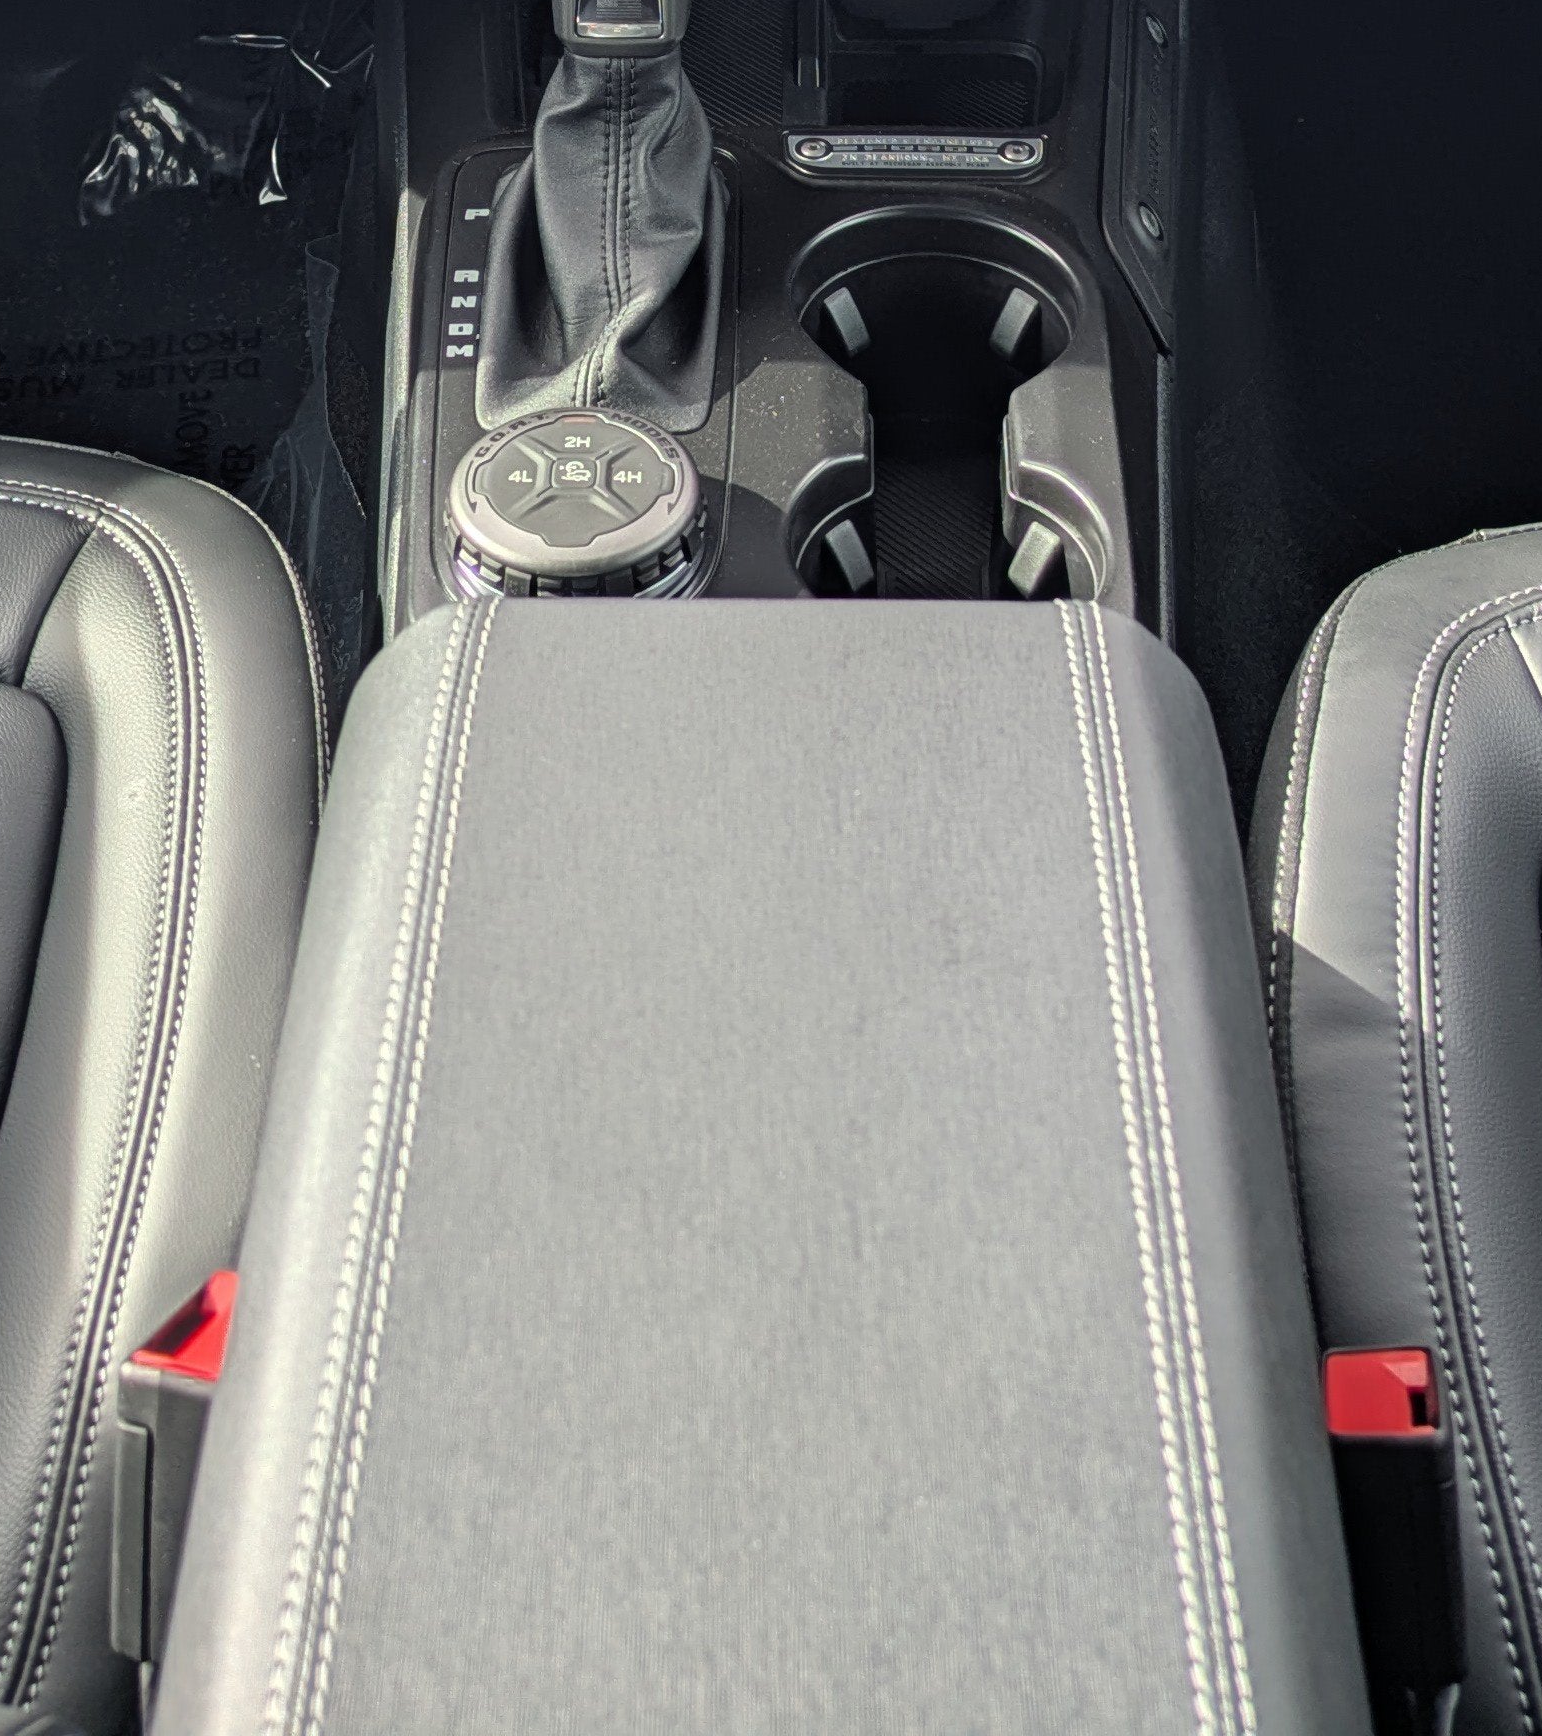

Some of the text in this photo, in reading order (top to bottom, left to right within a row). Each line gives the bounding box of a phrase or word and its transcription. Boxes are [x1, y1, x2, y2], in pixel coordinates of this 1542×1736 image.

[465, 208, 490, 220] P
[451, 295, 477, 308] N
[448, 323, 473, 335] D
[446, 345, 474, 357] M
[476, 413, 680, 459] G.O.A.T. MODES
[564, 435, 591, 448] 2H
[508, 470, 533, 483] 4L
[613, 470, 642, 484] 4H
